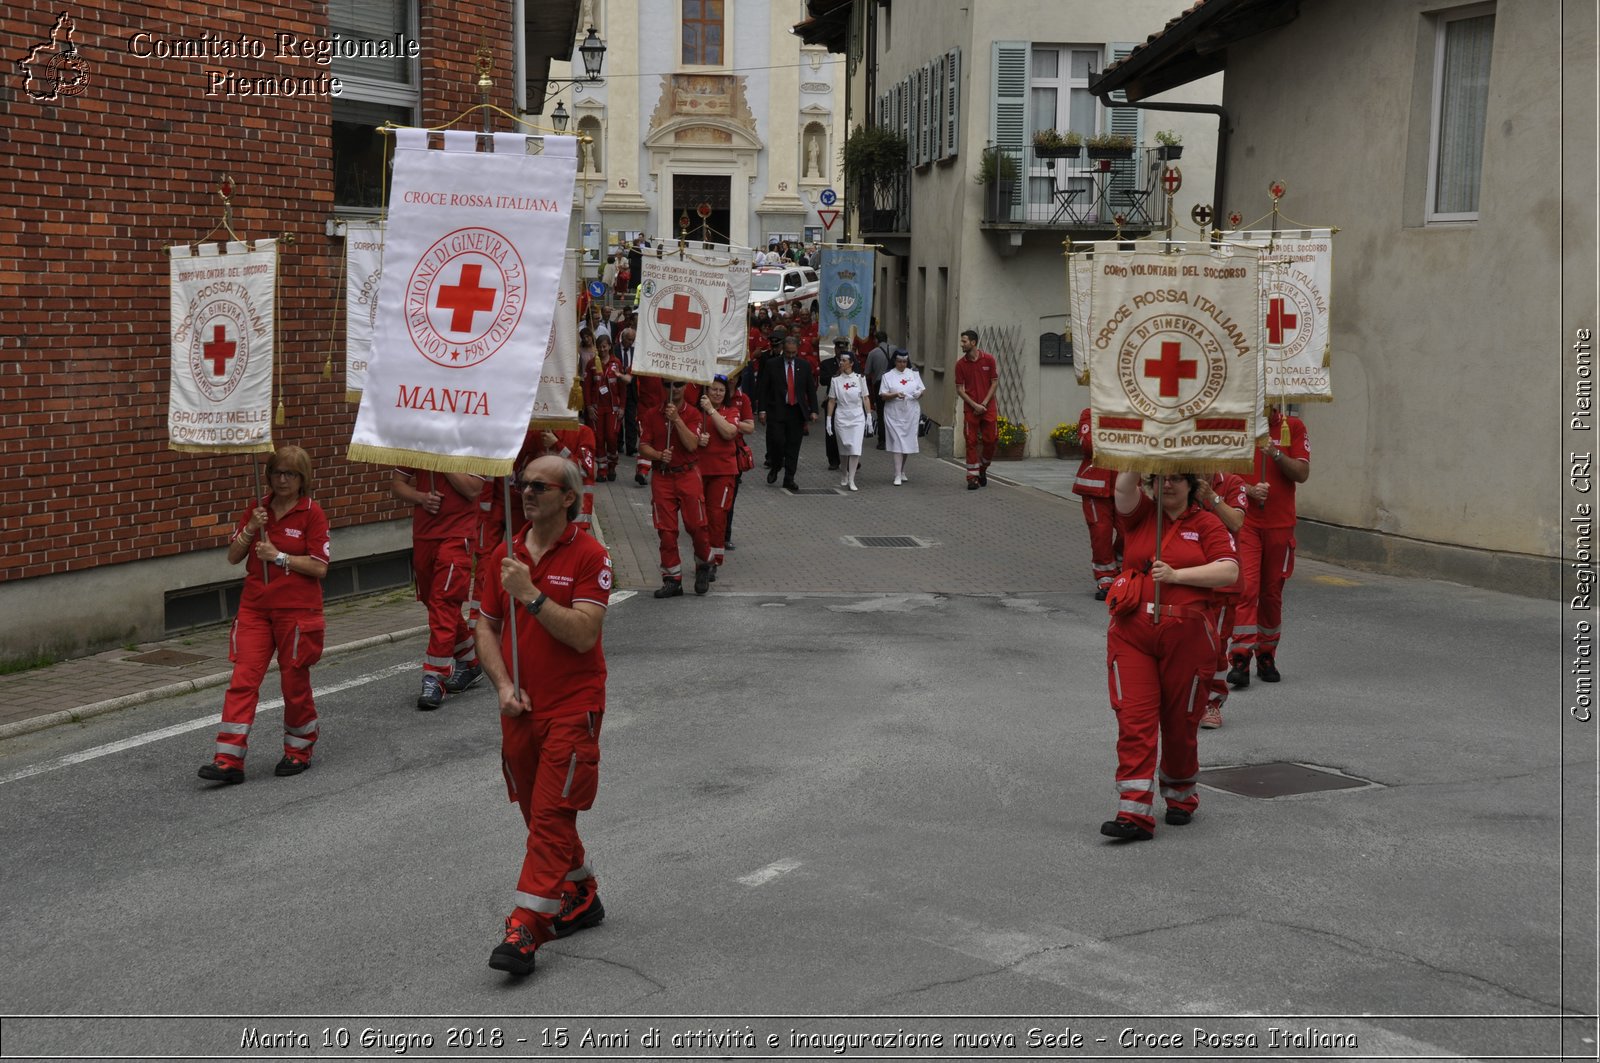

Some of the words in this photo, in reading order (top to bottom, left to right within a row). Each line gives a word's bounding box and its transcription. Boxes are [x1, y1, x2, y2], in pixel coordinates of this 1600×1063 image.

[404, 190, 448, 206] CROCE
[450, 193, 493, 209] ROSSA
[495, 197, 559, 213] ITALIANA
[433, 243, 451, 264] DI
[452, 233, 509, 264] GINEVRA
[1283, 244, 1294, 252] DEL
[228, 267, 240, 277] DEL
[504, 263, 521, 282] 22
[642, 270, 667, 280] CROCE
[668, 274, 693, 284] ROSSA
[695, 277, 726, 288] ITALIANA
[1131, 264, 1177, 277] VOLONTARI
[1182, 265, 1199, 277] DEL
[1204, 266, 1247, 280] SOCCORSO
[1291, 269, 1327, 315] ITALIANA
[197, 281, 233, 302] ROSSA
[235, 285, 267, 338] ITALIANA
[209, 302, 242, 321] GINEVRA
[410, 258, 448, 359] CONVENZIONE
[490, 284, 521, 342] AGOSTO
[1298, 298, 1309, 309] 22
[1095, 304, 1133, 350] CROCE
[1133, 289, 1189, 310] ROSSA
[1193, 295, 1250, 358] ITALIANA
[1136, 326, 1150, 340] DI
[1152, 318, 1204, 339] GINEVRA
[1300, 311, 1312, 344] AGOSTO
[465, 338, 490, 361] 1864
[646, 350, 676, 361] COMITATO
[1204, 340, 1218, 354] 22
[651, 358, 698, 374] MORETTA
[1276, 366, 1311, 375] LOCALE
[1313, 367, 1320, 375] DI
[1121, 341, 1158, 418] CONVENZIONE
[1203, 358, 1224, 399] AGOSTO
[1273, 377, 1326, 386] DALMAZZO
[395, 384, 490, 416] MANTA
[173, 411, 213, 424] GRUPPO
[216, 411, 222, 423] DI
[227, 409, 267, 424] MELLE
[171, 425, 216, 441] COMITATO
[220, 427, 264, 440] LOCALE
[1098, 431, 1160, 448] COMITATO
[1163, 437, 1177, 448] DI
